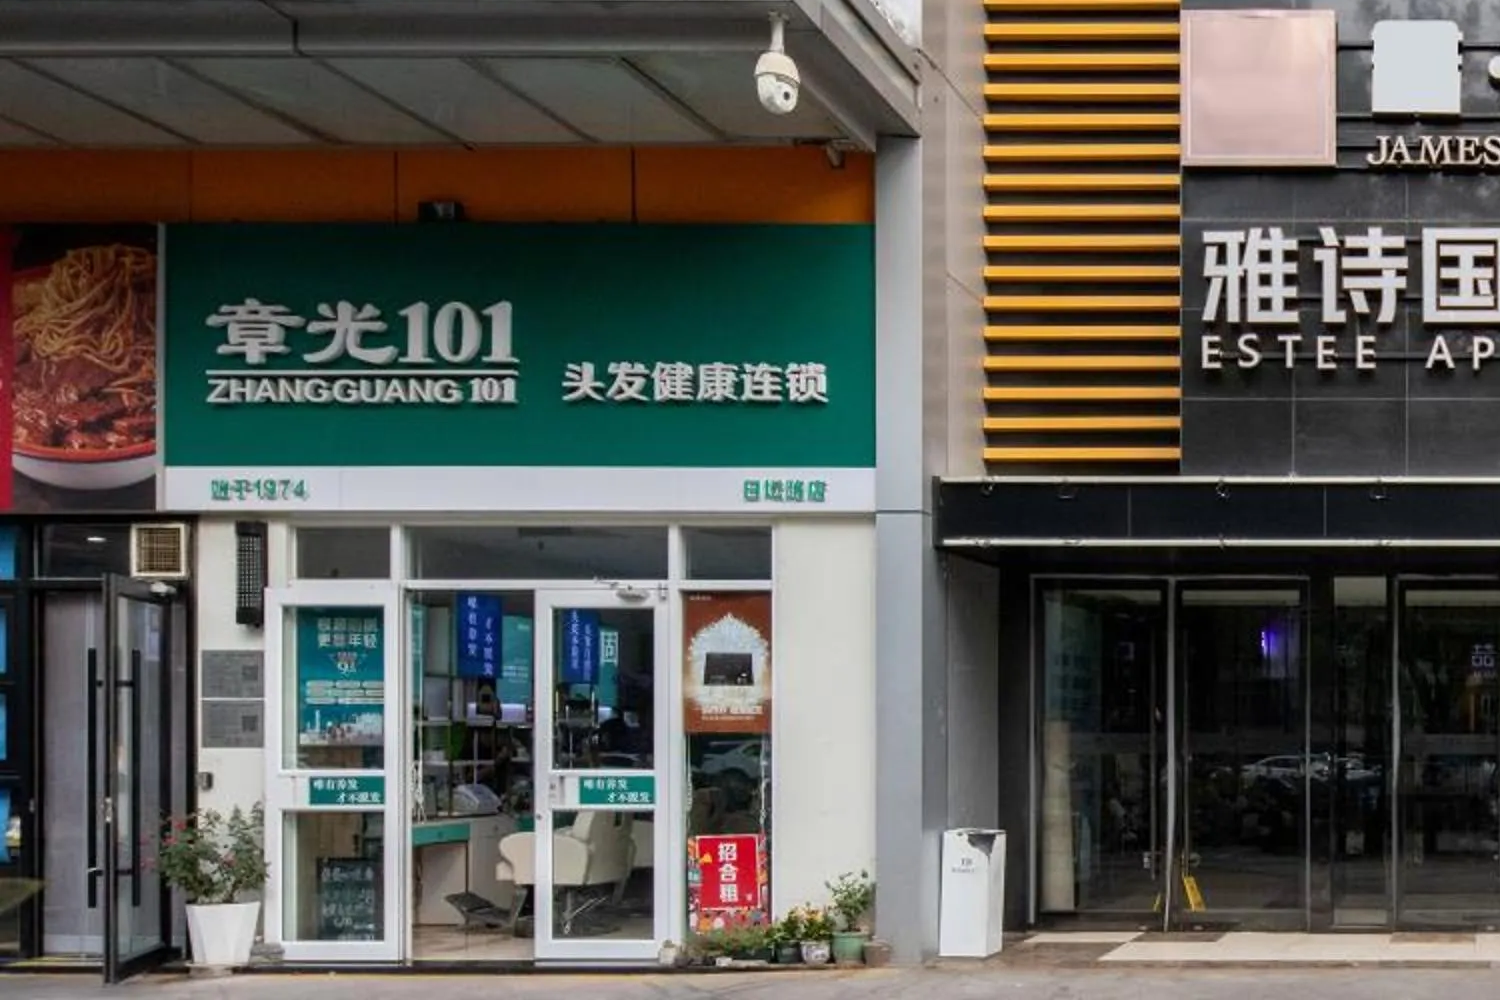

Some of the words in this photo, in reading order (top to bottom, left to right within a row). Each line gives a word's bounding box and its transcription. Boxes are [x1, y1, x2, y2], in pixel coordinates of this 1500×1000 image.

[205, 298, 521, 365] 章光101
[1201, 335, 1379, 370] ESTEE
[205, 378, 463, 404] ZHANGGUANG
[469, 377, 519, 404] 101
[561, 361, 830, 404] 头发健康连锁
